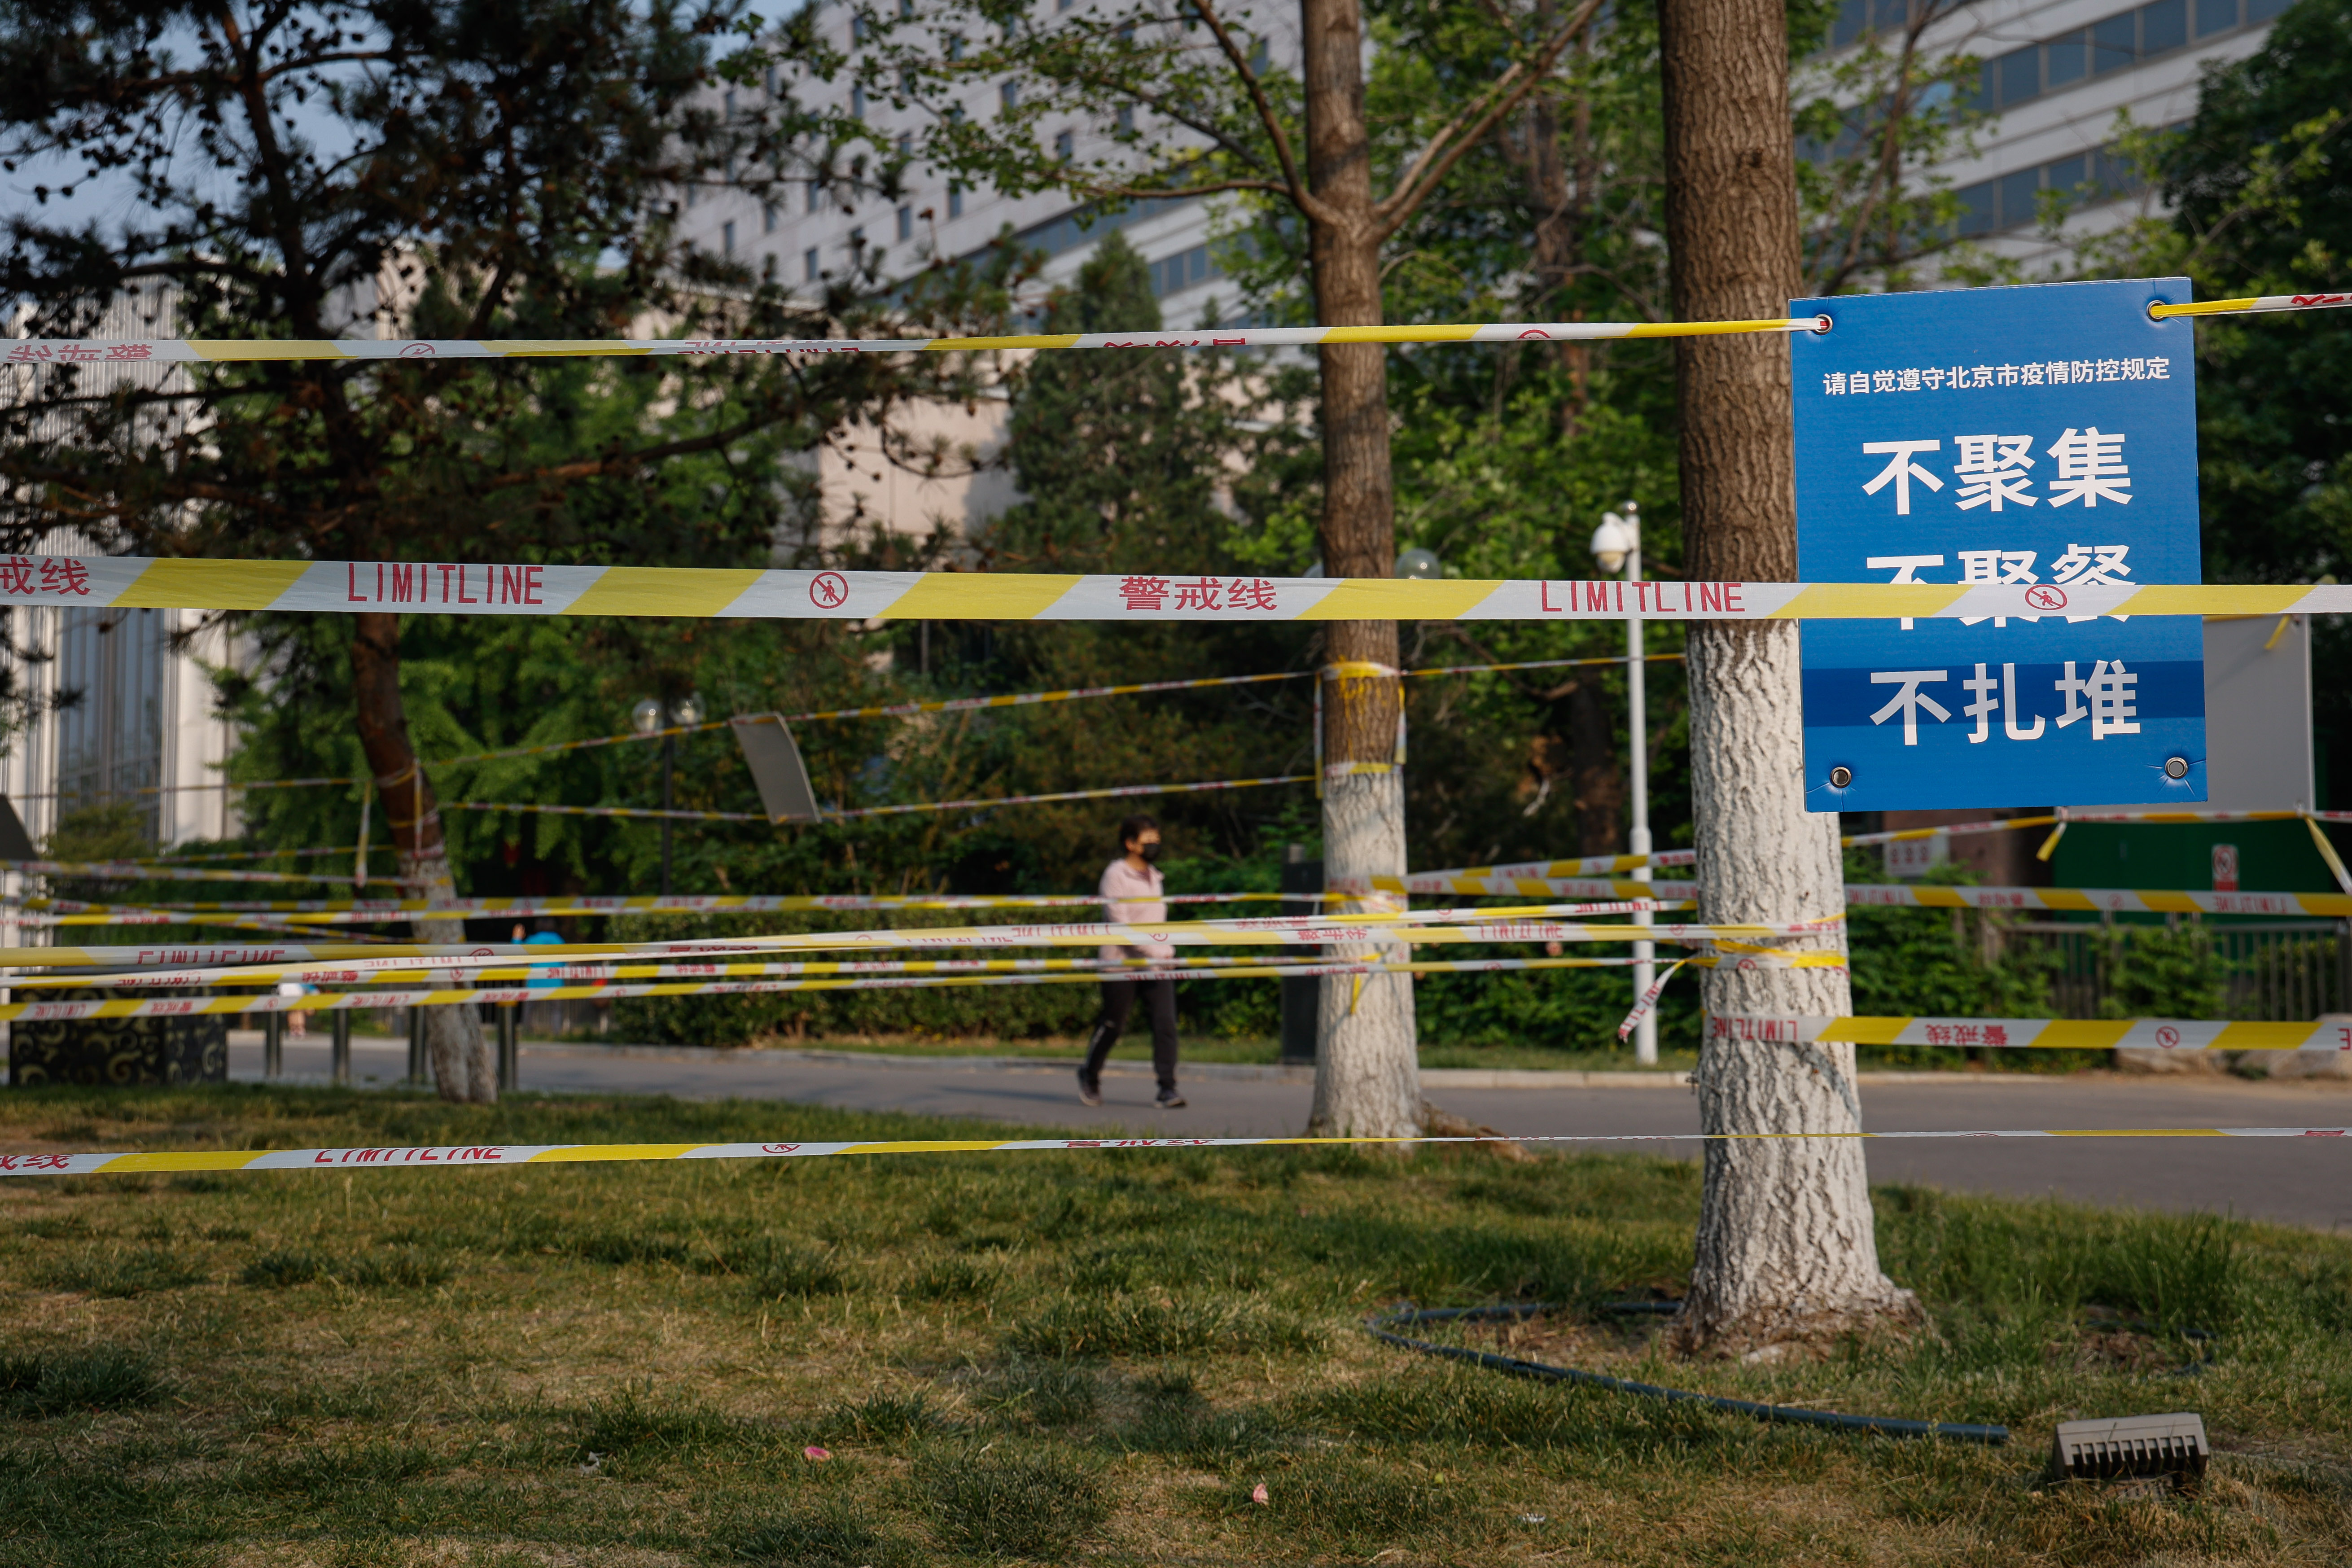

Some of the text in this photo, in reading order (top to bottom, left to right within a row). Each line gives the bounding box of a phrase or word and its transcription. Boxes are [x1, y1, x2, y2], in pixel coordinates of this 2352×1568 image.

[1823, 356, 2170, 396] 请自觉遵守北京市疫情防控规定
[1862, 426, 2133, 515] 不聚集
[348, 563, 543, 604] LIMITLINE
[1119, 576, 1277, 611] 警戒线
[1542, 581, 1745, 612] LIMITLINE
[1870, 659, 2140, 745] 不扎堆
